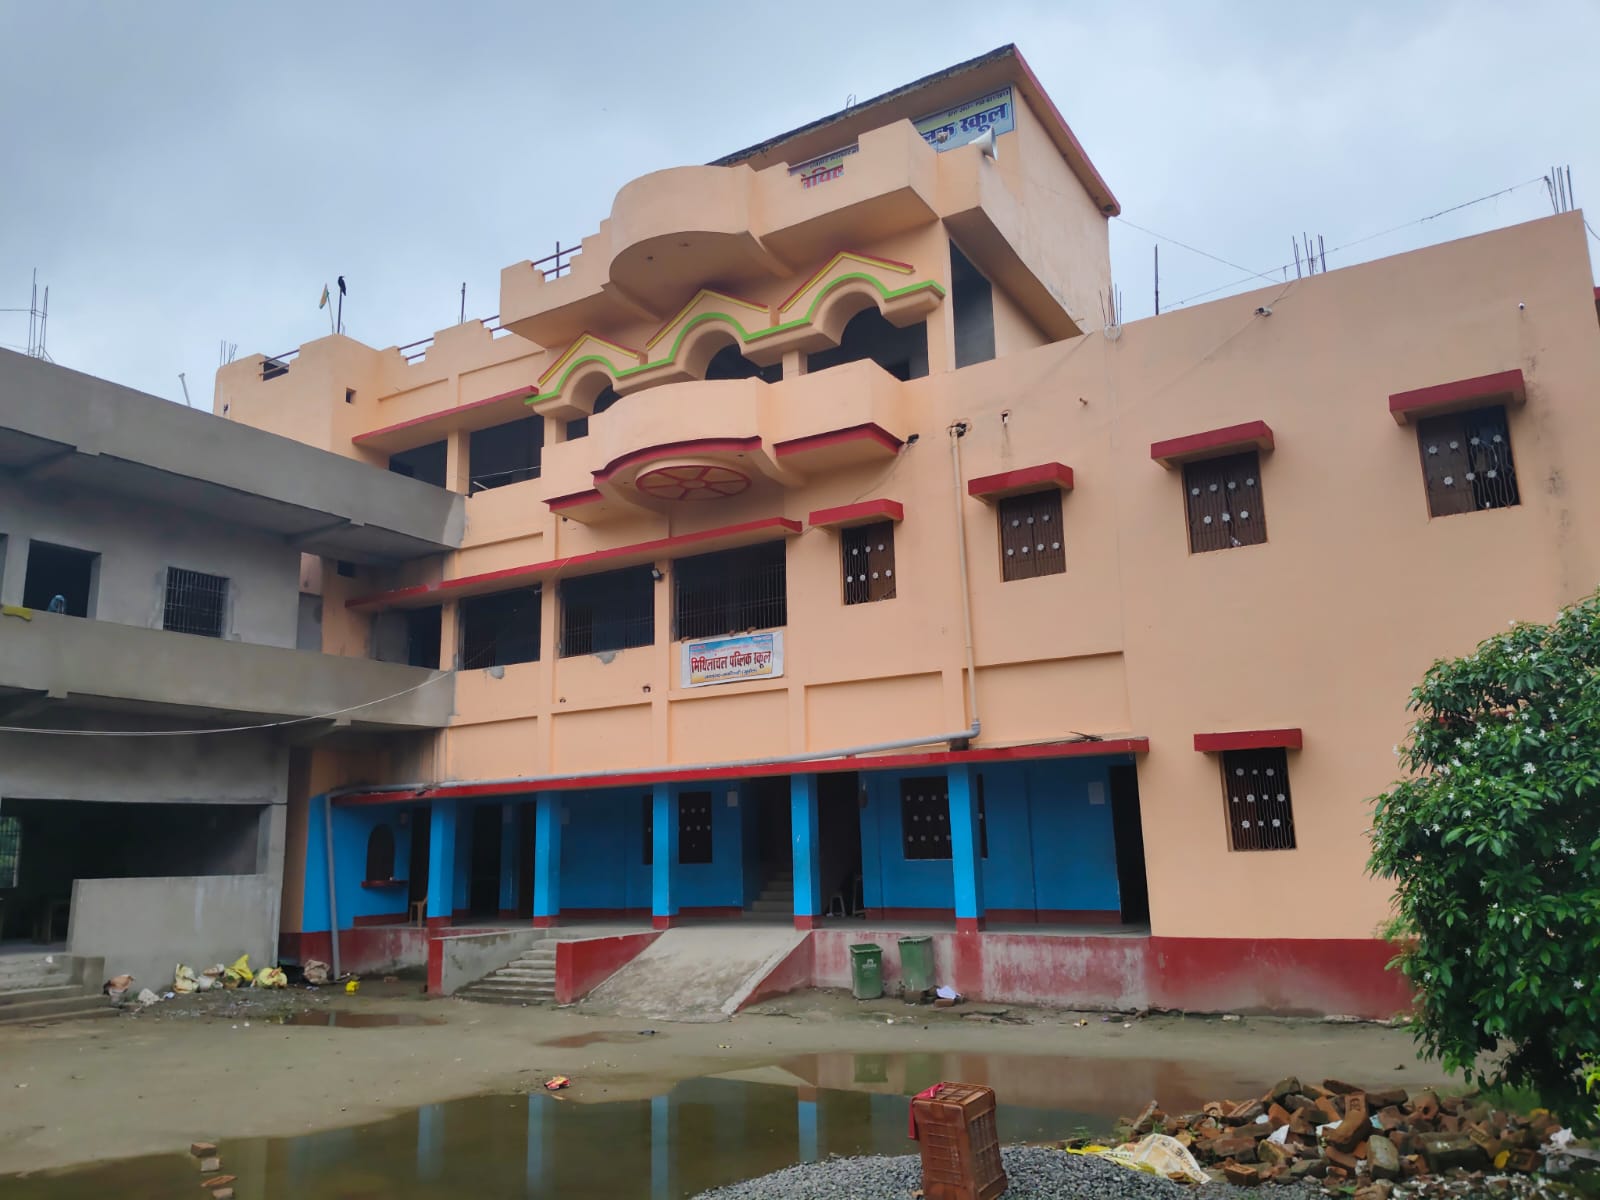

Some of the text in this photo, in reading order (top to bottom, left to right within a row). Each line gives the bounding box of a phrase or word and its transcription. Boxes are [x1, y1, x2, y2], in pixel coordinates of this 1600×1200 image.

[959, 103, 1008, 133] स्कूल
[729, 651, 752, 668] पब्लिक
[754, 651, 771, 669] स्कूल
